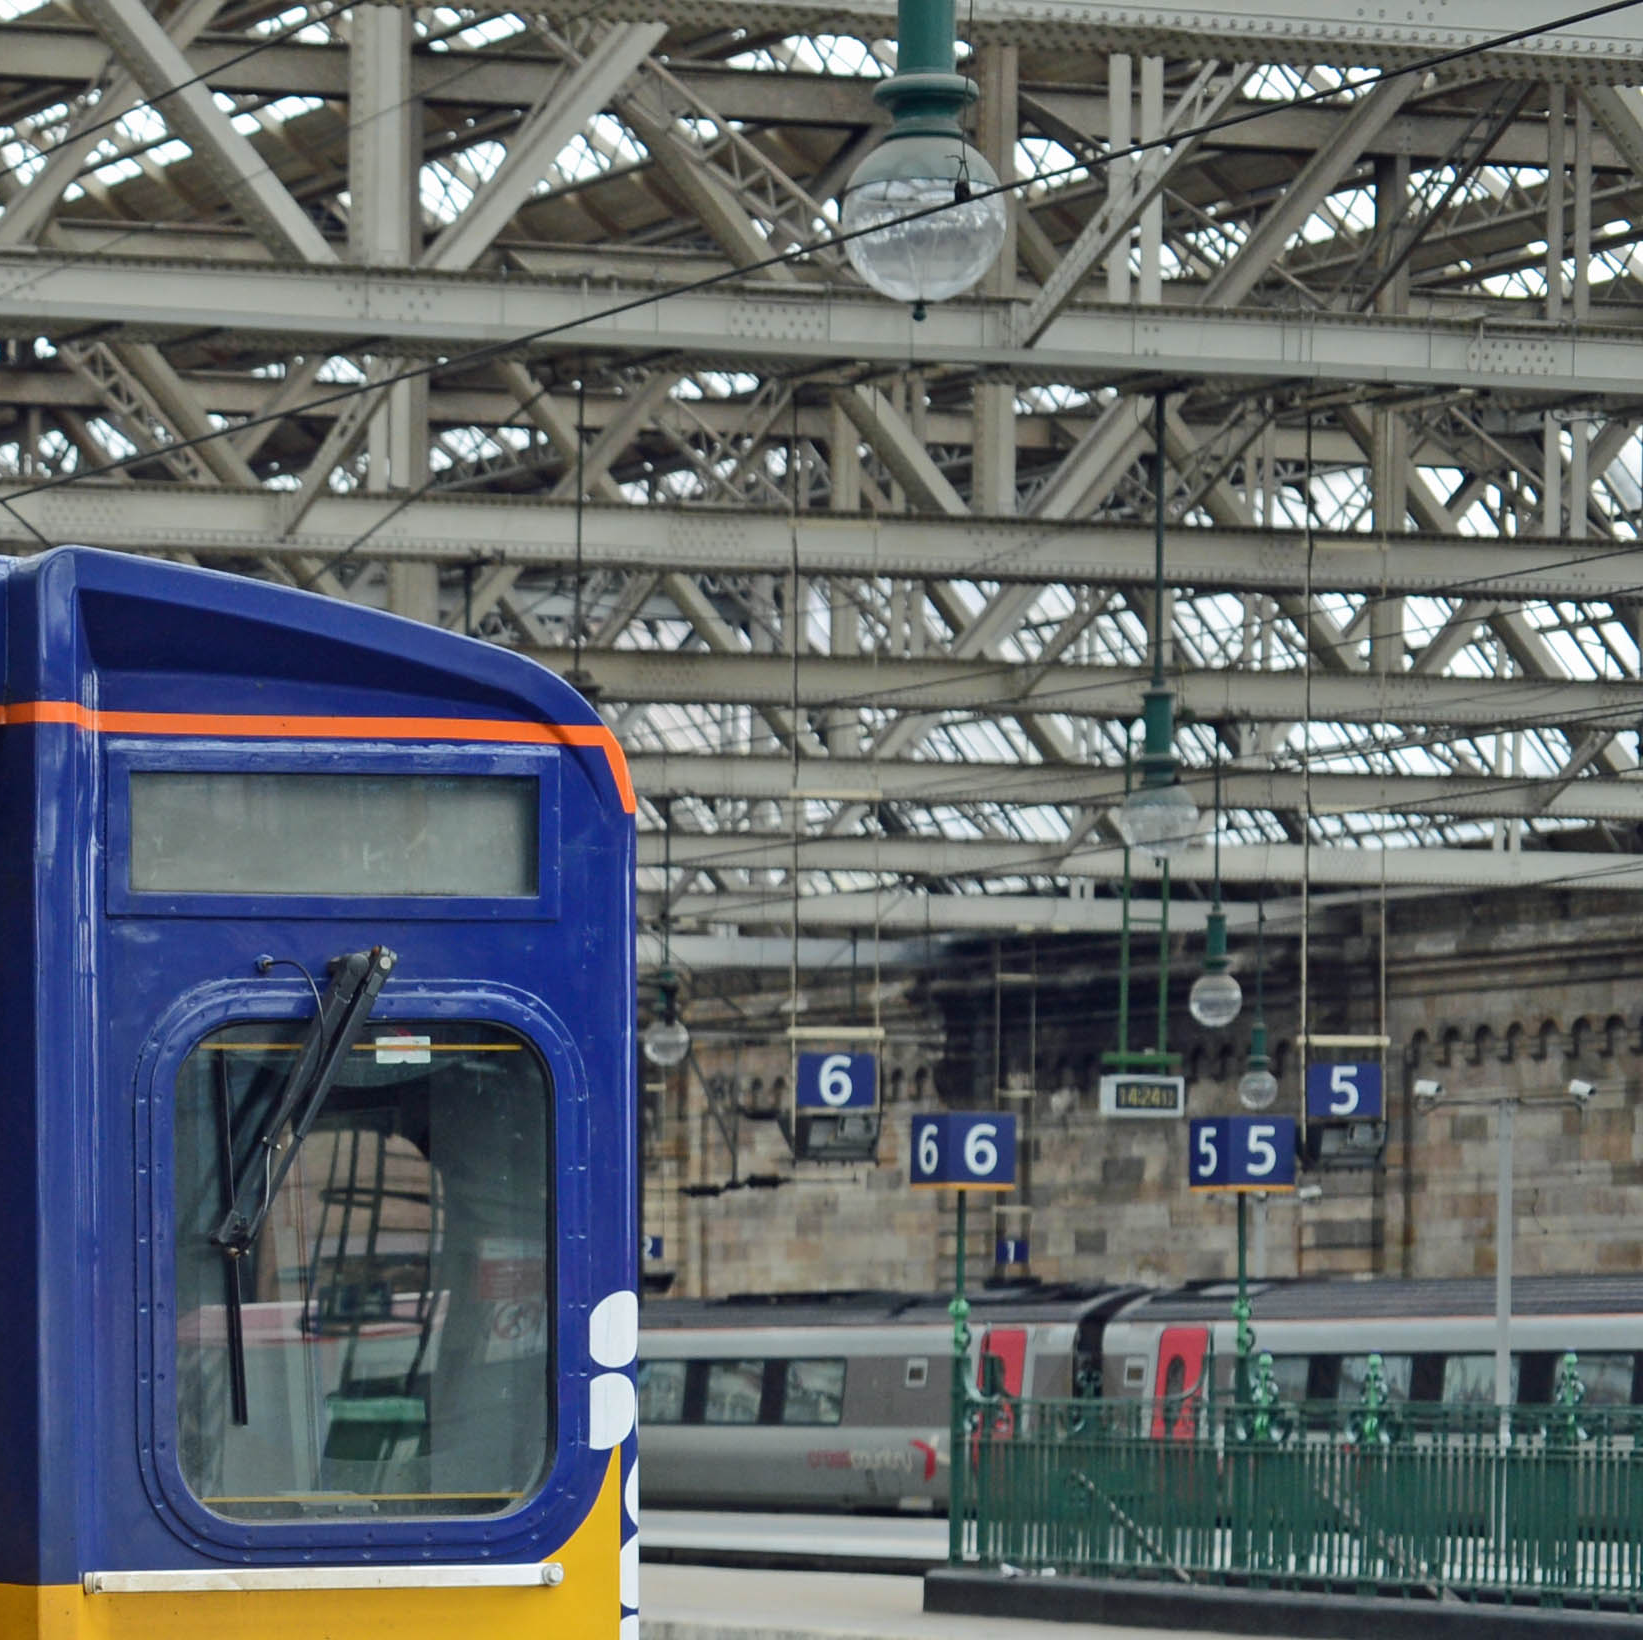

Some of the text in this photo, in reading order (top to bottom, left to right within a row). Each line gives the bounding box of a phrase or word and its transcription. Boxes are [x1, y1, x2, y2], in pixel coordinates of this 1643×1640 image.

[819, 1054, 853, 1106] 6
[1330, 1065, 1359, 1115] 5
[918, 1123, 939, 1175] 6
[965, 1122, 998, 1176] 6
[1197, 1126, 1218, 1177] 5
[1246, 1125, 1277, 1176] 5
